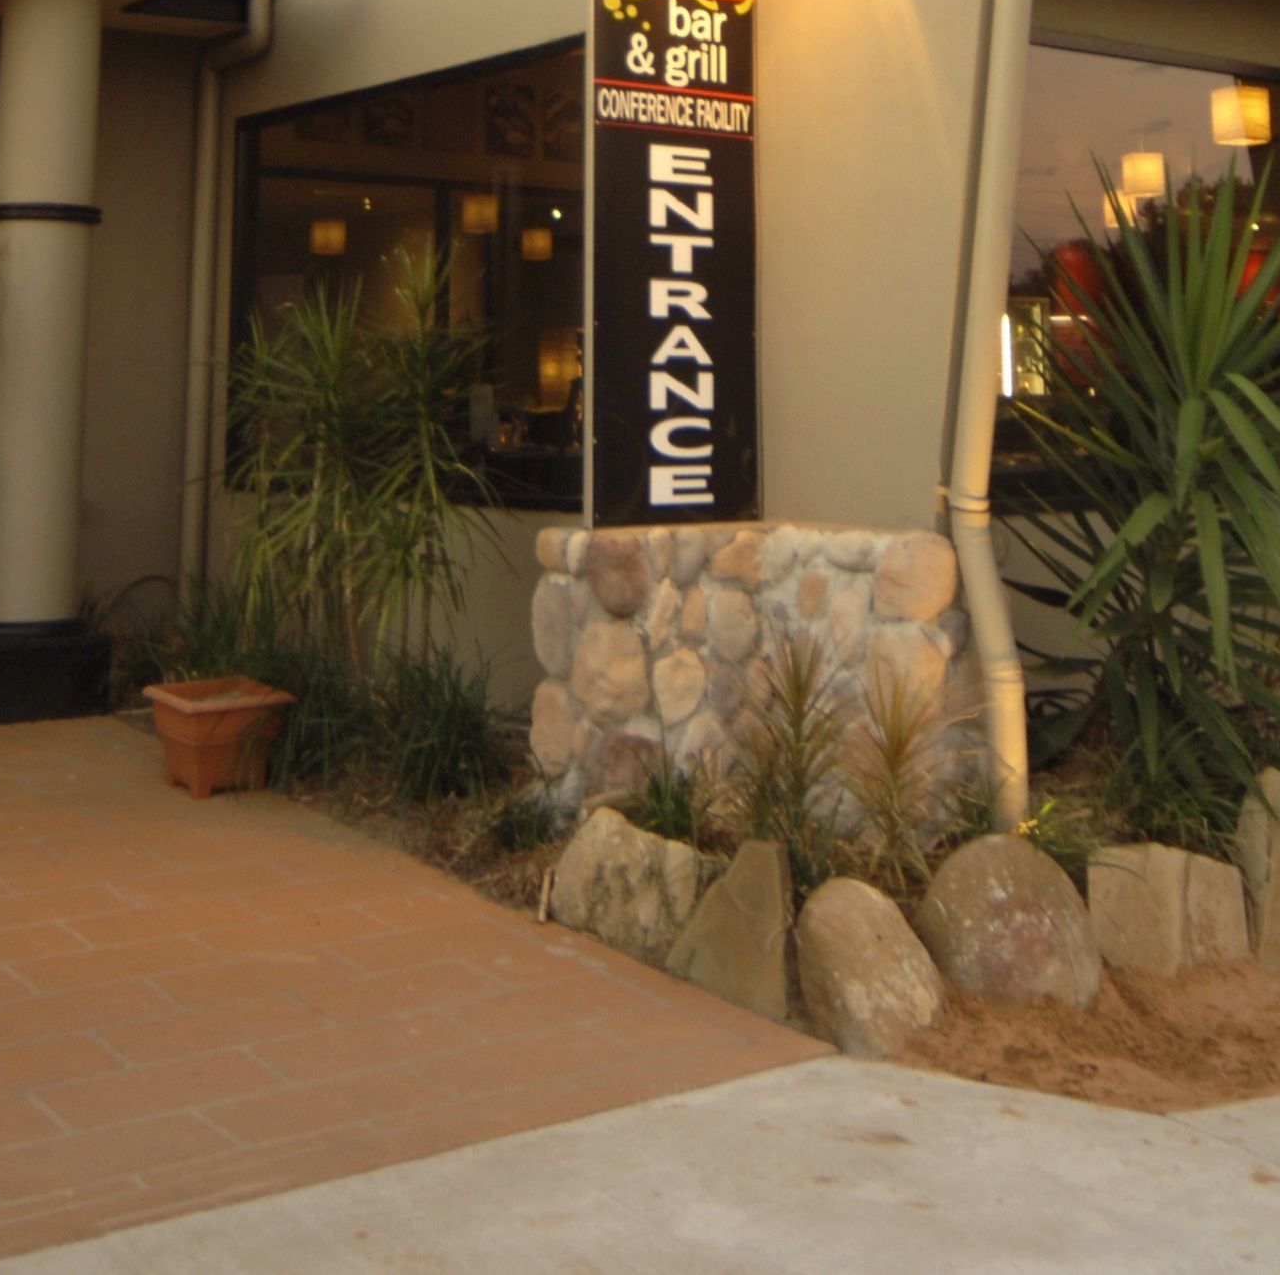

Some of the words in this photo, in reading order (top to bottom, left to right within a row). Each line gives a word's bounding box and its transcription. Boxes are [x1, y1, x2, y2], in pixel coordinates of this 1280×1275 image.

[626, 32, 656, 75] &
[665, 43, 727, 87] grill
[598, 88, 695, 127] CONFERENCE
[696, 98, 751, 133] FACILITY
[649, 143, 714, 507] ENTRANCE
